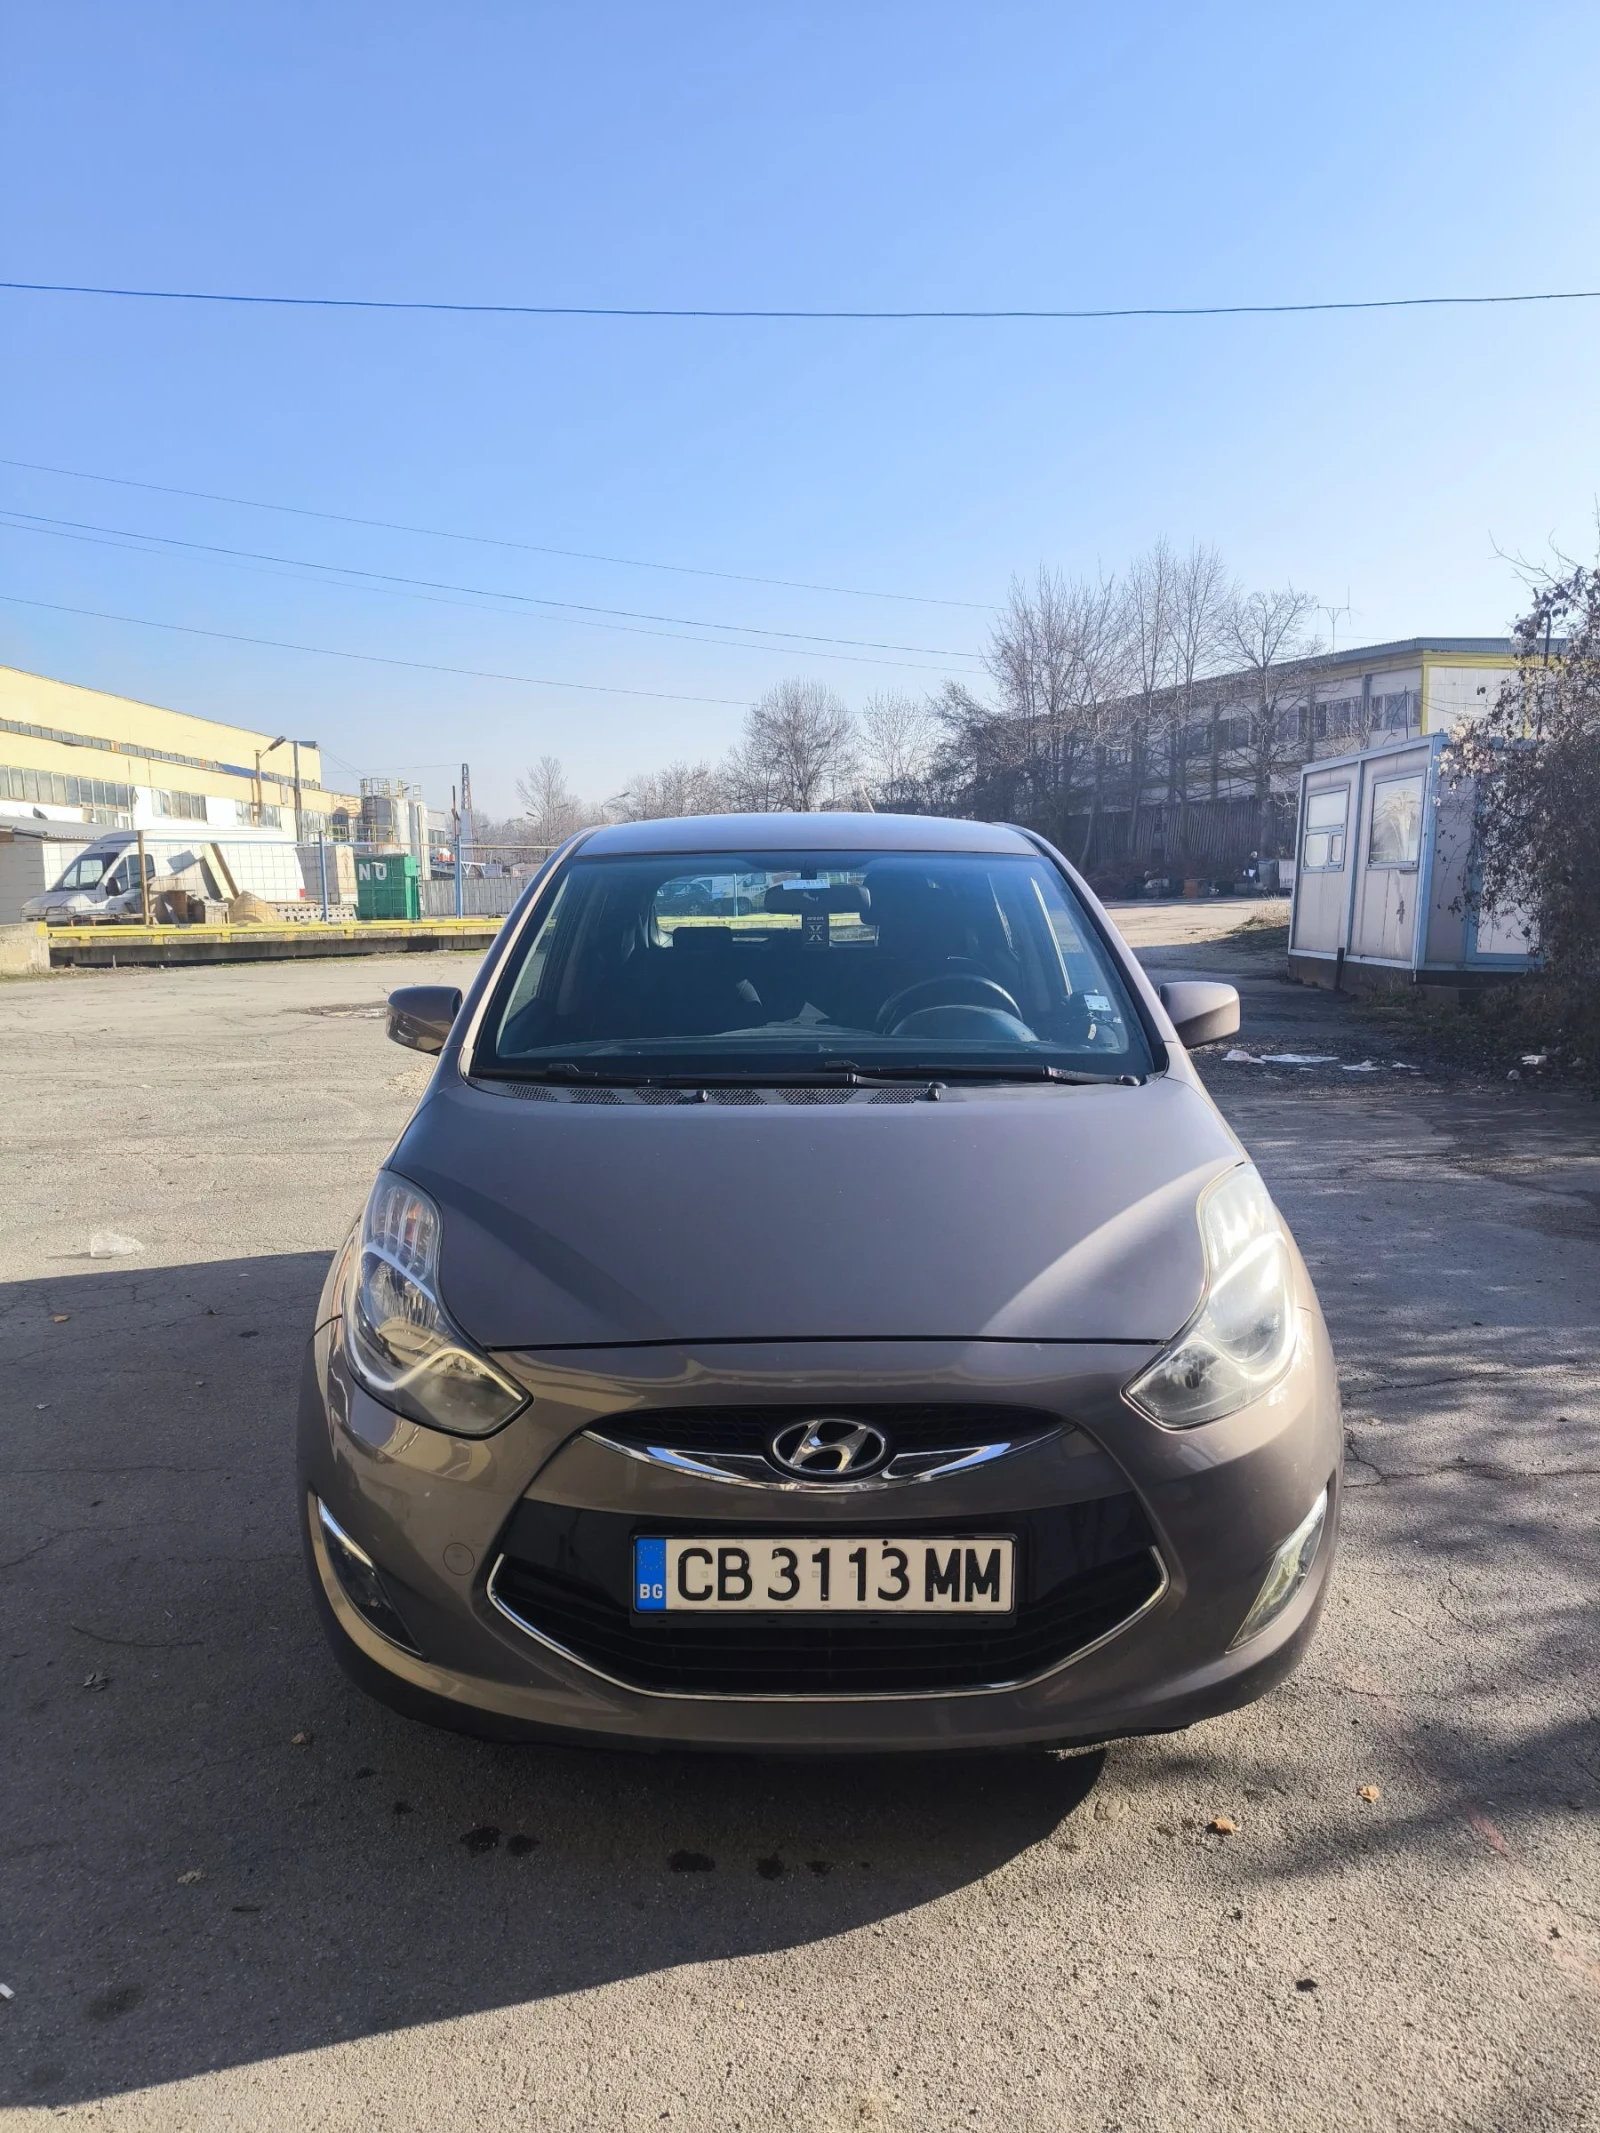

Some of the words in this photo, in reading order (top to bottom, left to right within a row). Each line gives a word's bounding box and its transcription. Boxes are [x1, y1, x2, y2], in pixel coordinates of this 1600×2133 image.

[639, 1583, 663, 1599] BG
[677, 1547, 753, 1602] CB
[767, 1547, 910, 1602] 3113
[924, 1547, 1001, 1603] MM
